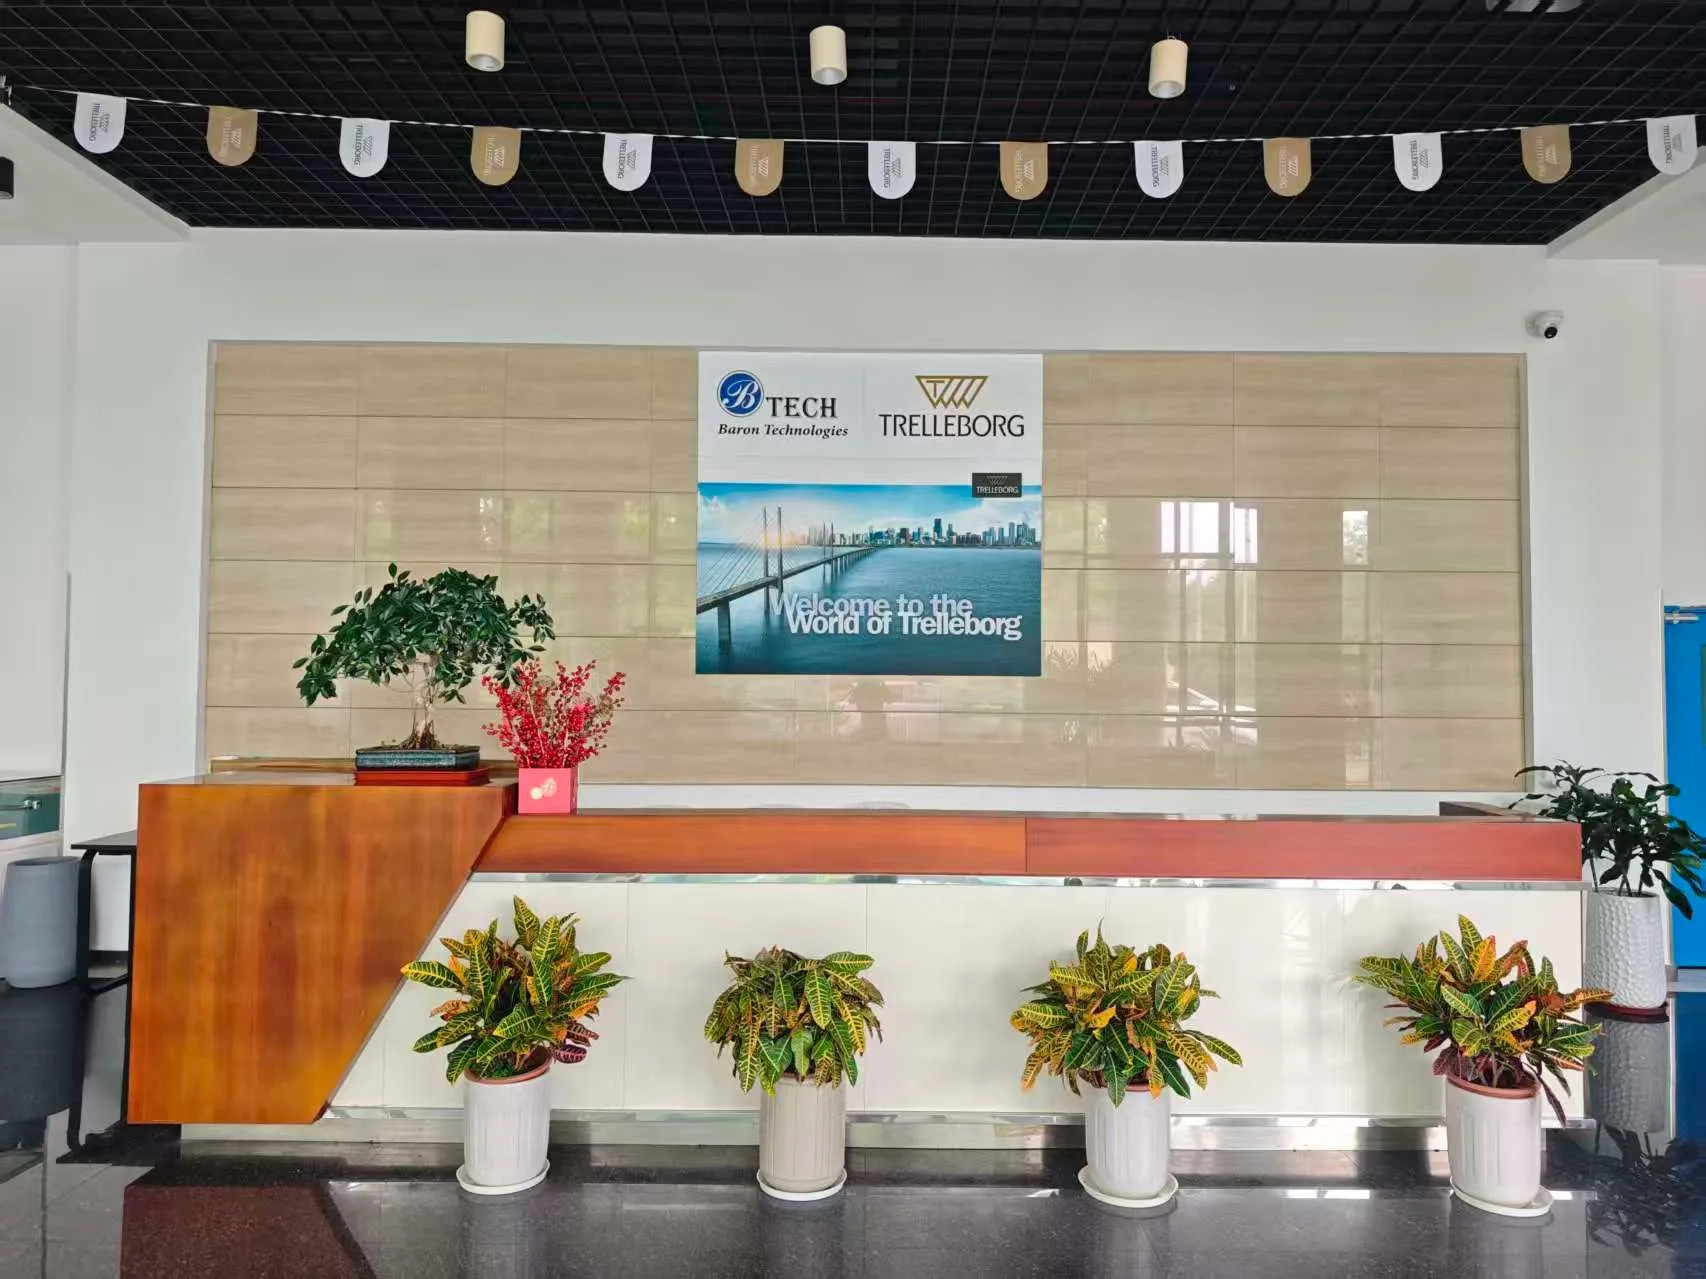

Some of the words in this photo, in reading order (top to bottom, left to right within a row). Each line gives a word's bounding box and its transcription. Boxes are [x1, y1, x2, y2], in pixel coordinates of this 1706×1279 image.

[722, 378, 759, 409] B
[765, 396, 837, 418] TECH
[718, 423, 760, 436] Baron
[764, 423, 848, 439] Technologies
[878, 413, 1025, 438] TRELLEBORG
[976, 486, 1019, 494] TRELLEBORG
[767, 592, 890, 617] Welcome
[896, 593, 923, 617] to
[930, 593, 973, 618] the
[786, 611, 860, 635] World
[867, 611, 893, 635] of
[898, 611, 1023, 641] Trelleborg
